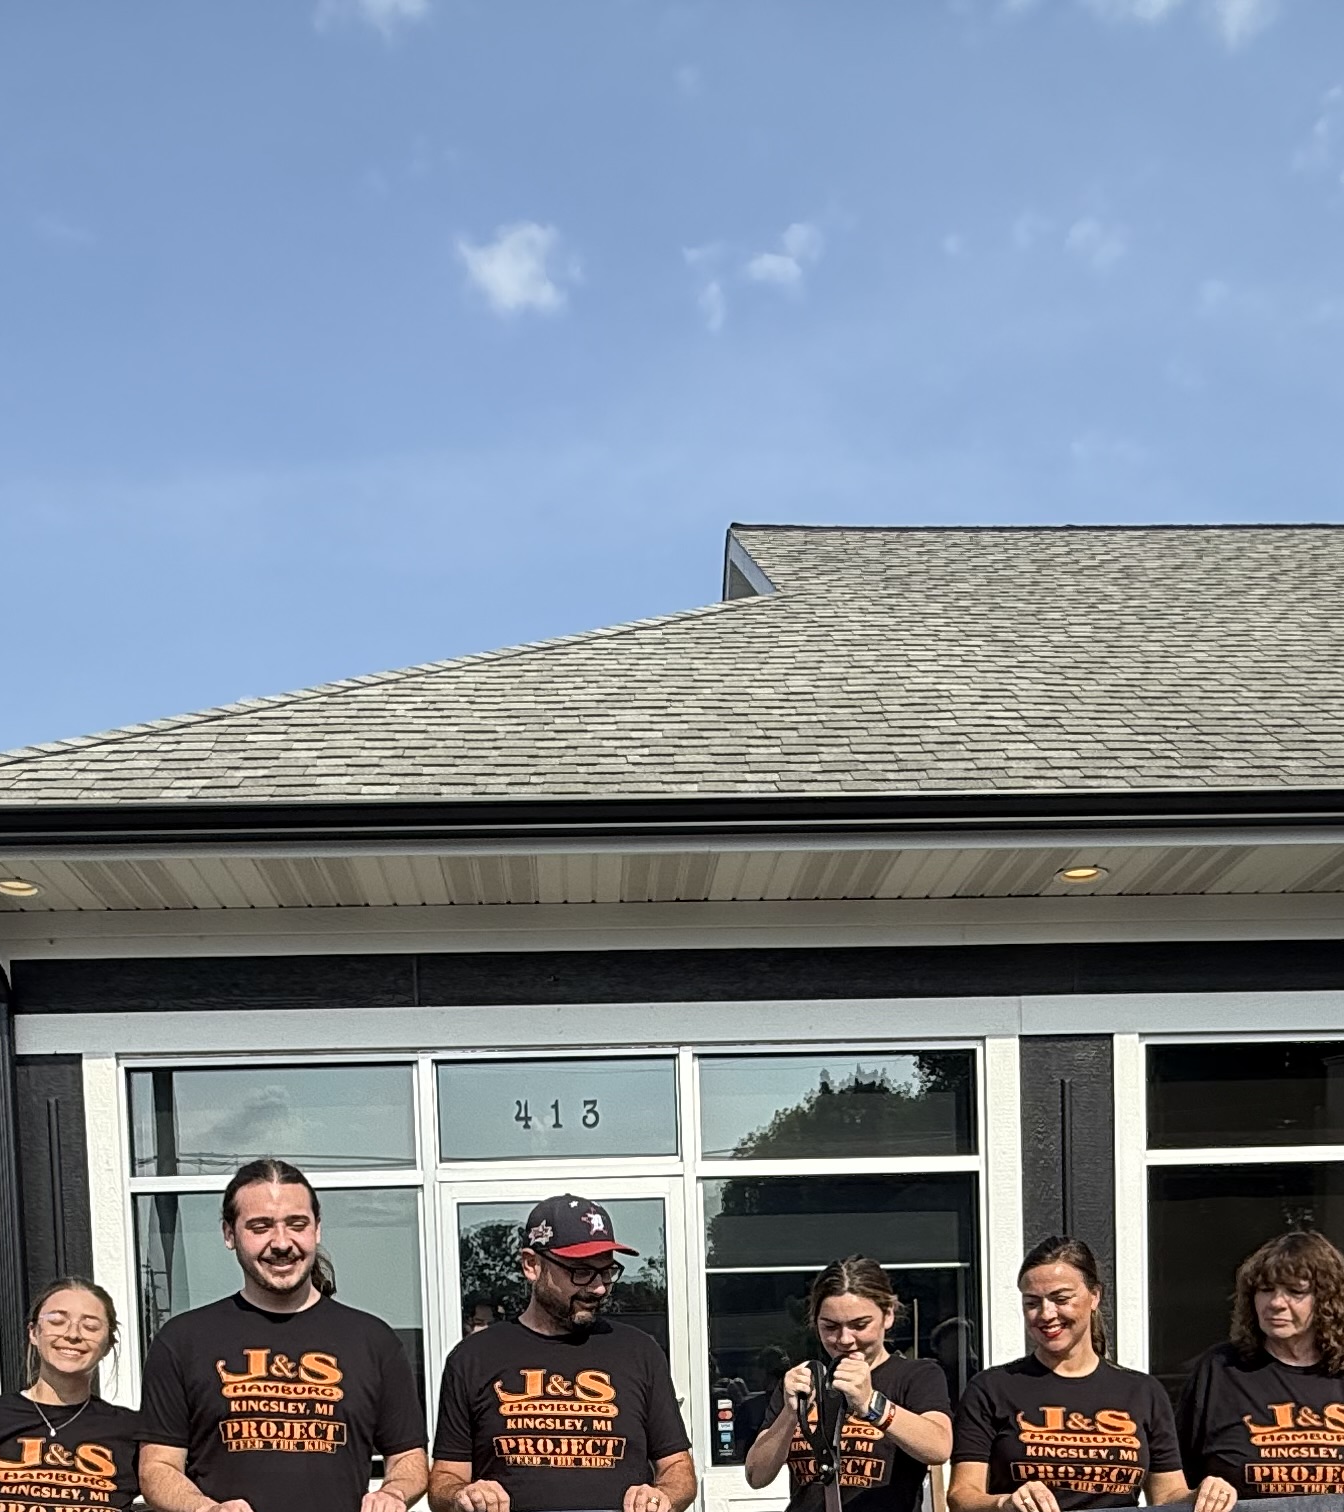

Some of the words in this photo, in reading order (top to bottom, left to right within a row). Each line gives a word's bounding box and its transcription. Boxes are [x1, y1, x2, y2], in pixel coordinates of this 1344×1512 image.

[216, 1348, 343, 1385] J&S
[232, 1384, 334, 1397] HAMBURG
[493, 1368, 616, 1402] J&S
[230, 1400, 310, 1415] KINGSLEY,
[314, 1403, 334, 1416] MI
[509, 1403, 610, 1413] HAMBURG
[506, 1418, 588, 1432] KINGSLEY,
[593, 1420, 612, 1431] MI
[1016, 1406, 1137, 1435] J&S
[226, 1421, 340, 1440] PROJECT
[1030, 1433, 1134, 1444] HAMBURG
[499, 1438, 619, 1456] PROJECT
[855, 1440, 874, 1452] MI
[1026, 1445, 1114, 1460] KINGSLEY,
[1119, 1449, 1138, 1462] MI
[1260, 1447, 1343, 1460] KINGSLEY,
[4, 1472, 107, 1488] HAMBURG
[1018, 1464, 1141, 1484] PROJECT
[0, 1484, 85, 1501] KINGSLEY,
[90, 1491, 109, 1502] MI
